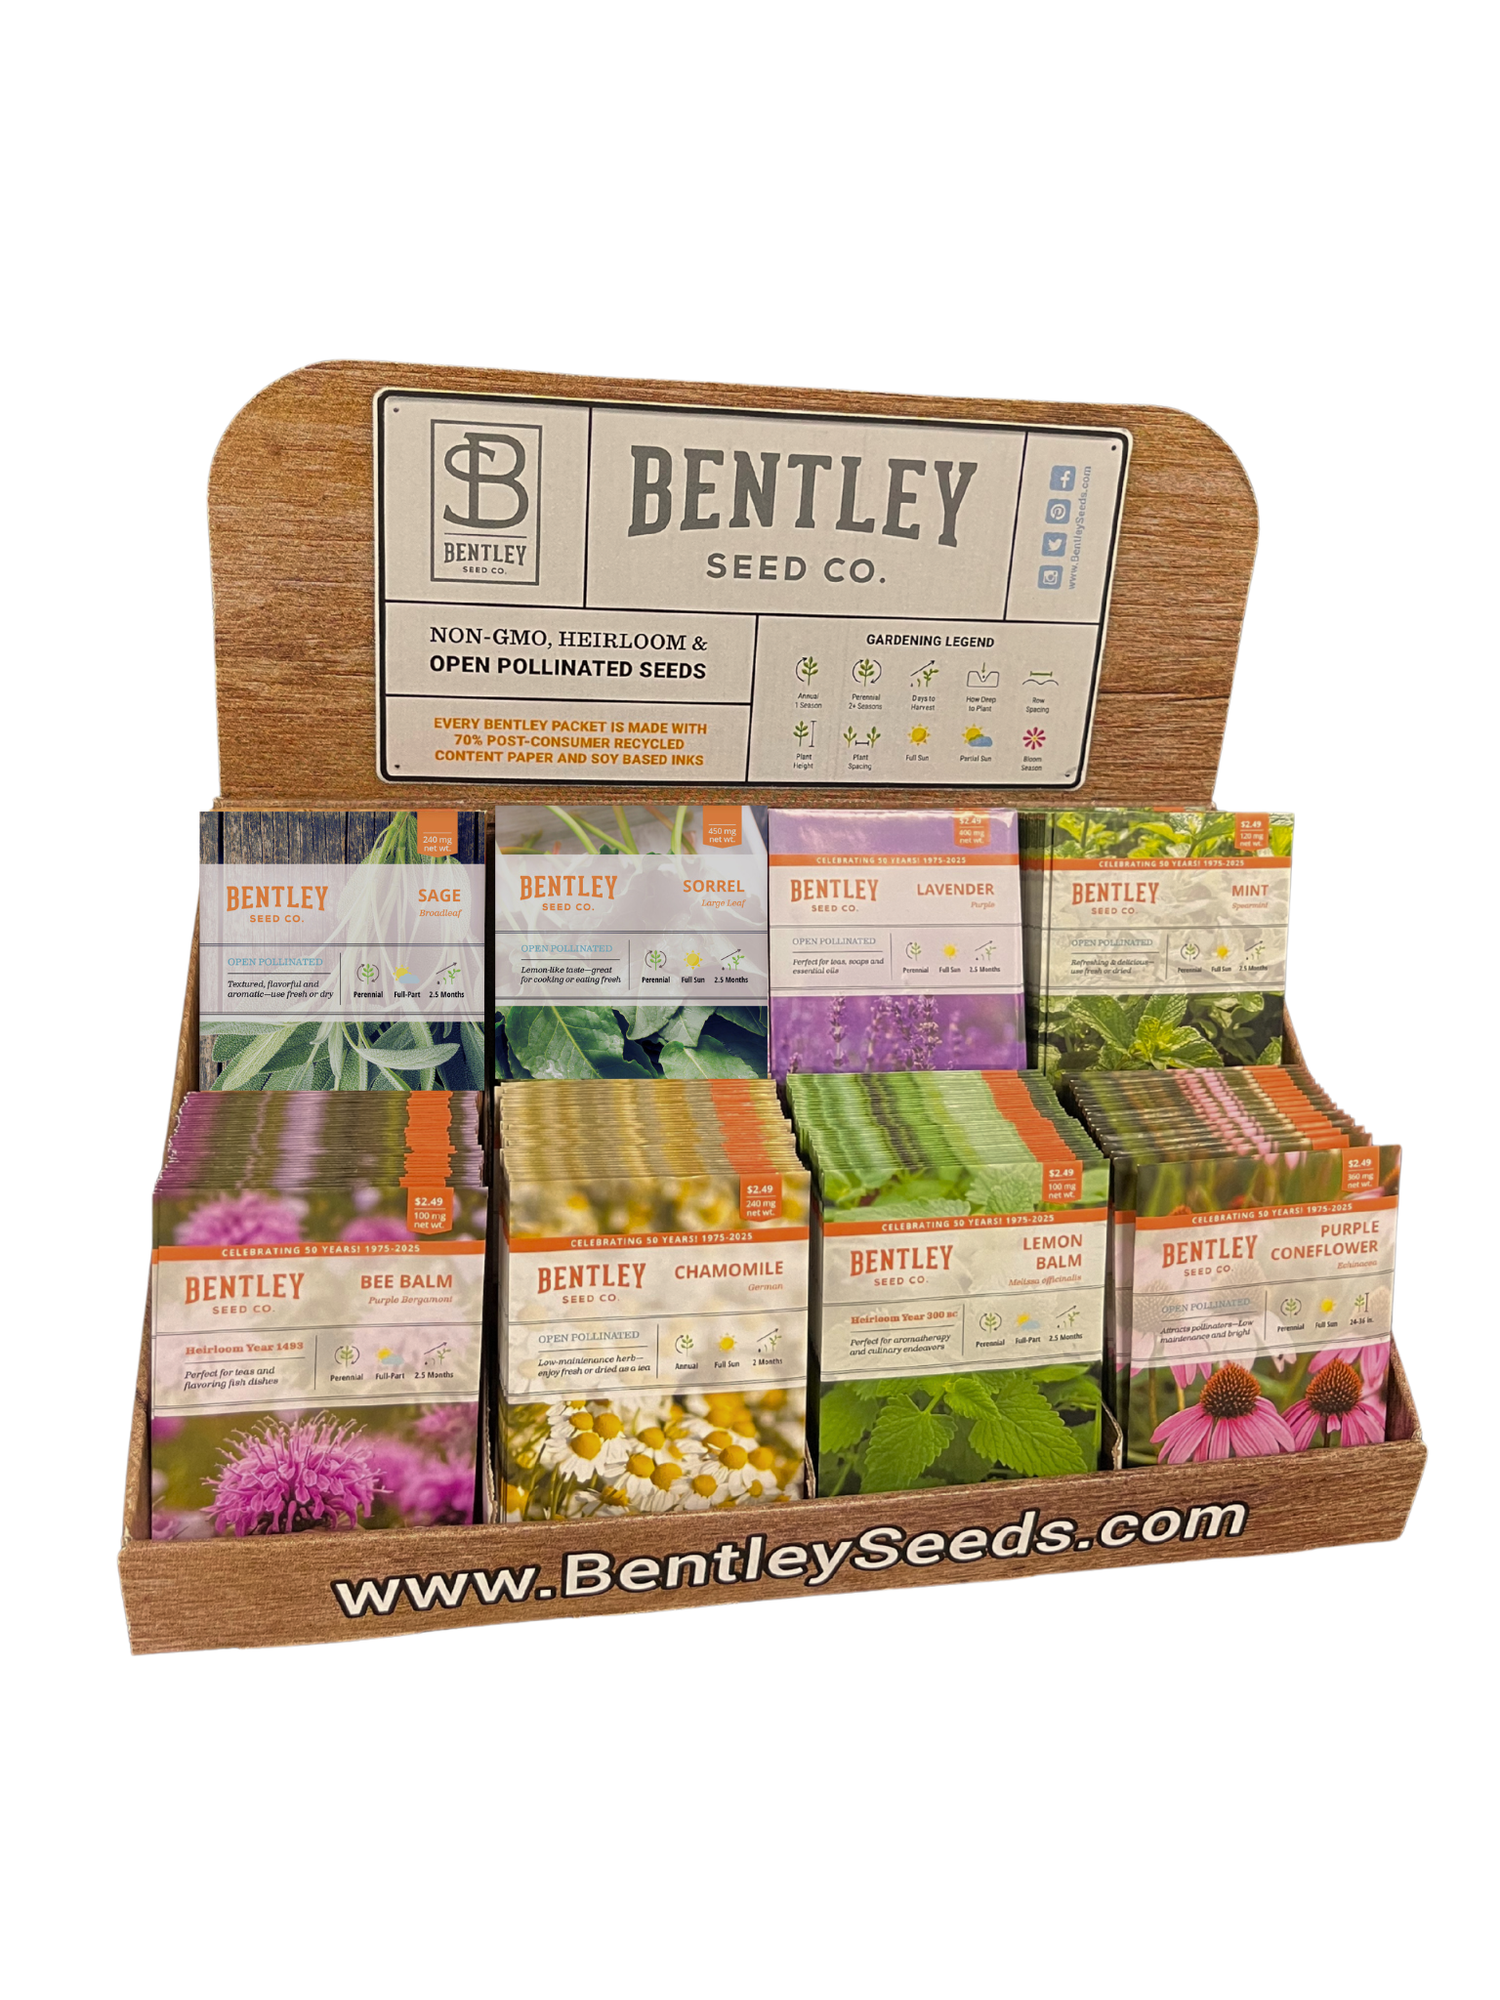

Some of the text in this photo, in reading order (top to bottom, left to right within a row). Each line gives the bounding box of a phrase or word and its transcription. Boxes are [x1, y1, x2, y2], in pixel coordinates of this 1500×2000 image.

[627, 444, 978, 547] BENTLEY
[1068, 466, 1092, 590] www.BentleySeeds.com
[444, 543, 526, 566] BENTLEY
[463, 566, 487, 574] SEED
[706, 552, 886, 584] SEED CO.
[430, 627, 707, 650] NON-GMO, HEIRLOOM &
[866, 634, 995, 648] GARDENING LEGEND
[430, 655, 706, 679] OPEN POLLINATED SEEDS
[797, 692, 819, 700] Annual
[912, 695, 927, 703] Days
[980, 696, 996, 704] Deep
[1025, 706, 1049, 714] Spacing
[434, 718, 707, 734] EVERY BENTLEY PACKET IS MADE WITH
[454, 734, 684, 749] 70% POST-CONSUMER RECYCLED
[435, 750, 704, 765] CONTENT PAPER AND SOY BASED INKS
[848, 763, 872, 771] Spacing
[724, 829, 736, 837] mg
[423, 836, 452, 845] 240 mg
[520, 875, 617, 900] BENTLEY
[683, 880, 744, 893] SORREL
[791, 879, 879, 902] BENTLEY
[917, 883, 994, 896] LAVENDER
[1232, 885, 1269, 896] MINT
[227, 886, 328, 912] BENTLEY
[418, 889, 461, 902] SAGE
[1072, 882, 1159, 905] BENTLEY
[419, 909, 462, 918] Broadleaf
[542, 903, 594, 911] SEED CO.
[250, 915, 304, 923] SEED CO.
[521, 945, 612, 953] OPEN POLLINATED
[228, 958, 323, 966] OPEN POLLINATED
[1348, 1159, 1372, 1167] $2.49
[1049, 1169, 1074, 1177] $2.49
[747, 1185, 773, 1194] $2.49
[415, 1197, 443, 1206] $2.49
[746, 1200, 776, 1209] 240 mg
[414, 1212, 446, 1222] 100 mg
[1192, 1203, 1352, 1224] CELEBRATING 50 YEARS! 1975-2025
[882, 1214, 1054, 1231] CELEBRATING 50 YEARS! 1975-2025
[1321, 1221, 1379, 1237] PURPLE
[571, 1233, 752, 1247] CELEBRATING 50 YEARS! 1975-2025
[1023, 1234, 1083, 1250] LEMON
[222, 1245, 420, 1257] CELEBRATING 50 YEARS! 1975-2025
[1162, 1235, 1257, 1268] BENTLEY
[1271, 1240, 1378, 1261] CONEFLOWER
[850, 1245, 953, 1276] BENTLEY
[1036, 1254, 1081, 1270] BALM
[675, 1261, 783, 1279] CHAMOMILE
[1184, 1265, 1234, 1277] SEED CO.
[361, 1275, 453, 1289] BEE BALM
[537, 1263, 646, 1294] BENTLEY
[874, 1276, 928, 1286] SEED CO.
[185, 1273, 304, 1304] BENTLEY
[748, 1282, 783, 1291] German
[562, 1294, 620, 1304] SEED CO.
[213, 1305, 275, 1315] SEED CO.
[185, 1342, 304, 1355] Heirloom Year 1493
[184, 1370, 217, 1380] Perfect
[217, 1369, 233, 1379] for
[257, 1367, 275, 1375] and
[334, 1500, 1249, 1618] www.BentleySeeds.com
